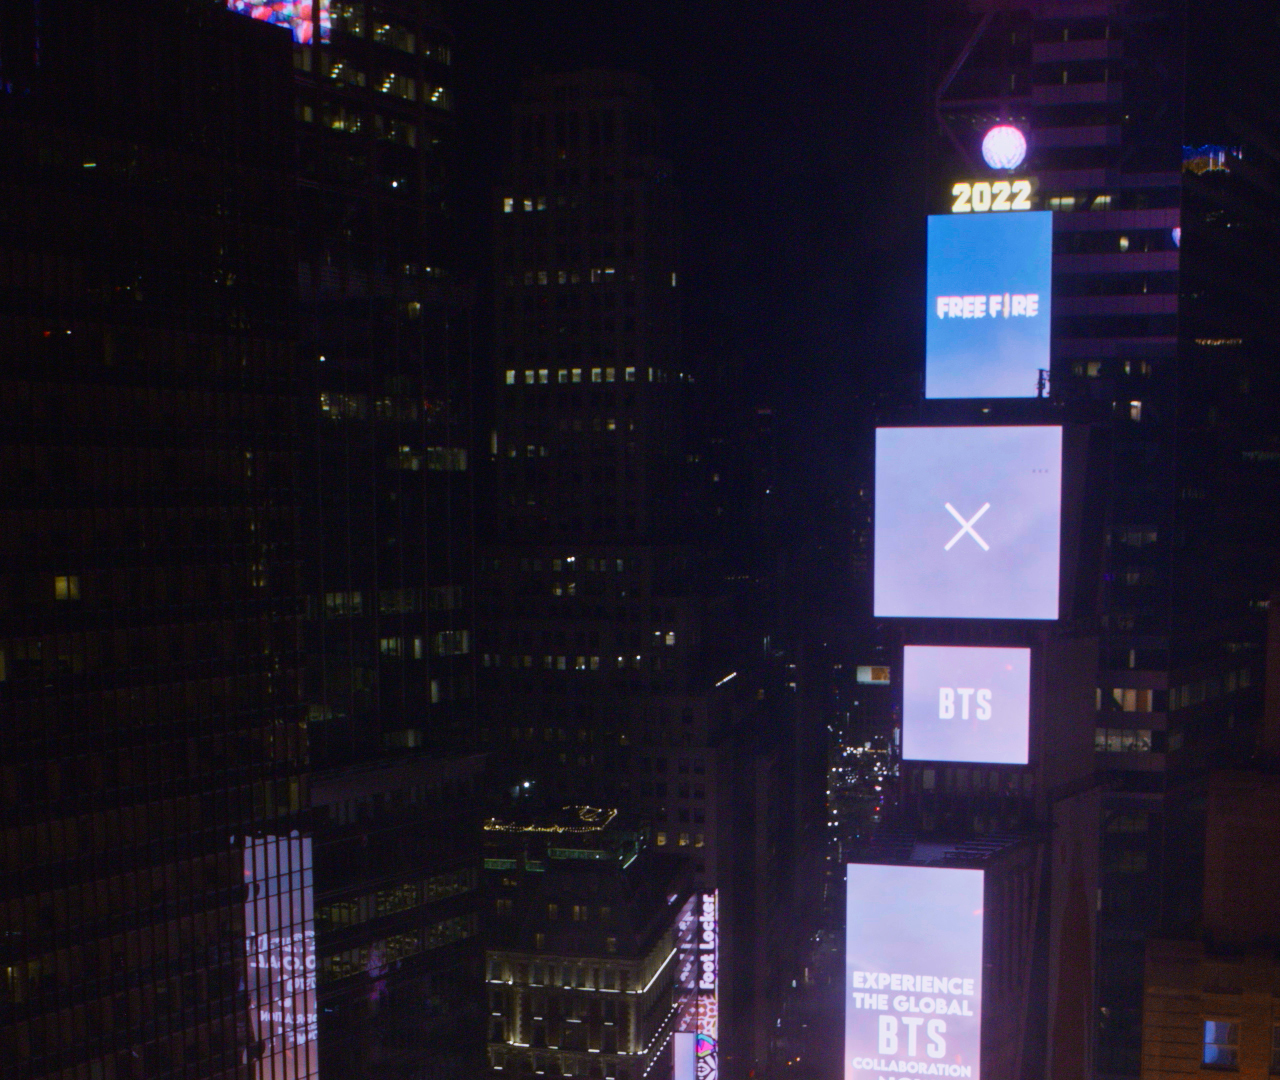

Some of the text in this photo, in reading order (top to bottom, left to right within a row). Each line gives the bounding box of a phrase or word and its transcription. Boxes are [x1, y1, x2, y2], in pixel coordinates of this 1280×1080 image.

[951, 180, 1032, 213] 2022
[936, 293, 1039, 320] FREE FIRE
[938, 687, 993, 721] BTS
[852, 971, 975, 996] EXPERIENCE
[852, 992, 973, 1017] THE GLOBAL
[878, 1014, 947, 1059] BTS
[852, 1057, 972, 1078] COLLABORATION
